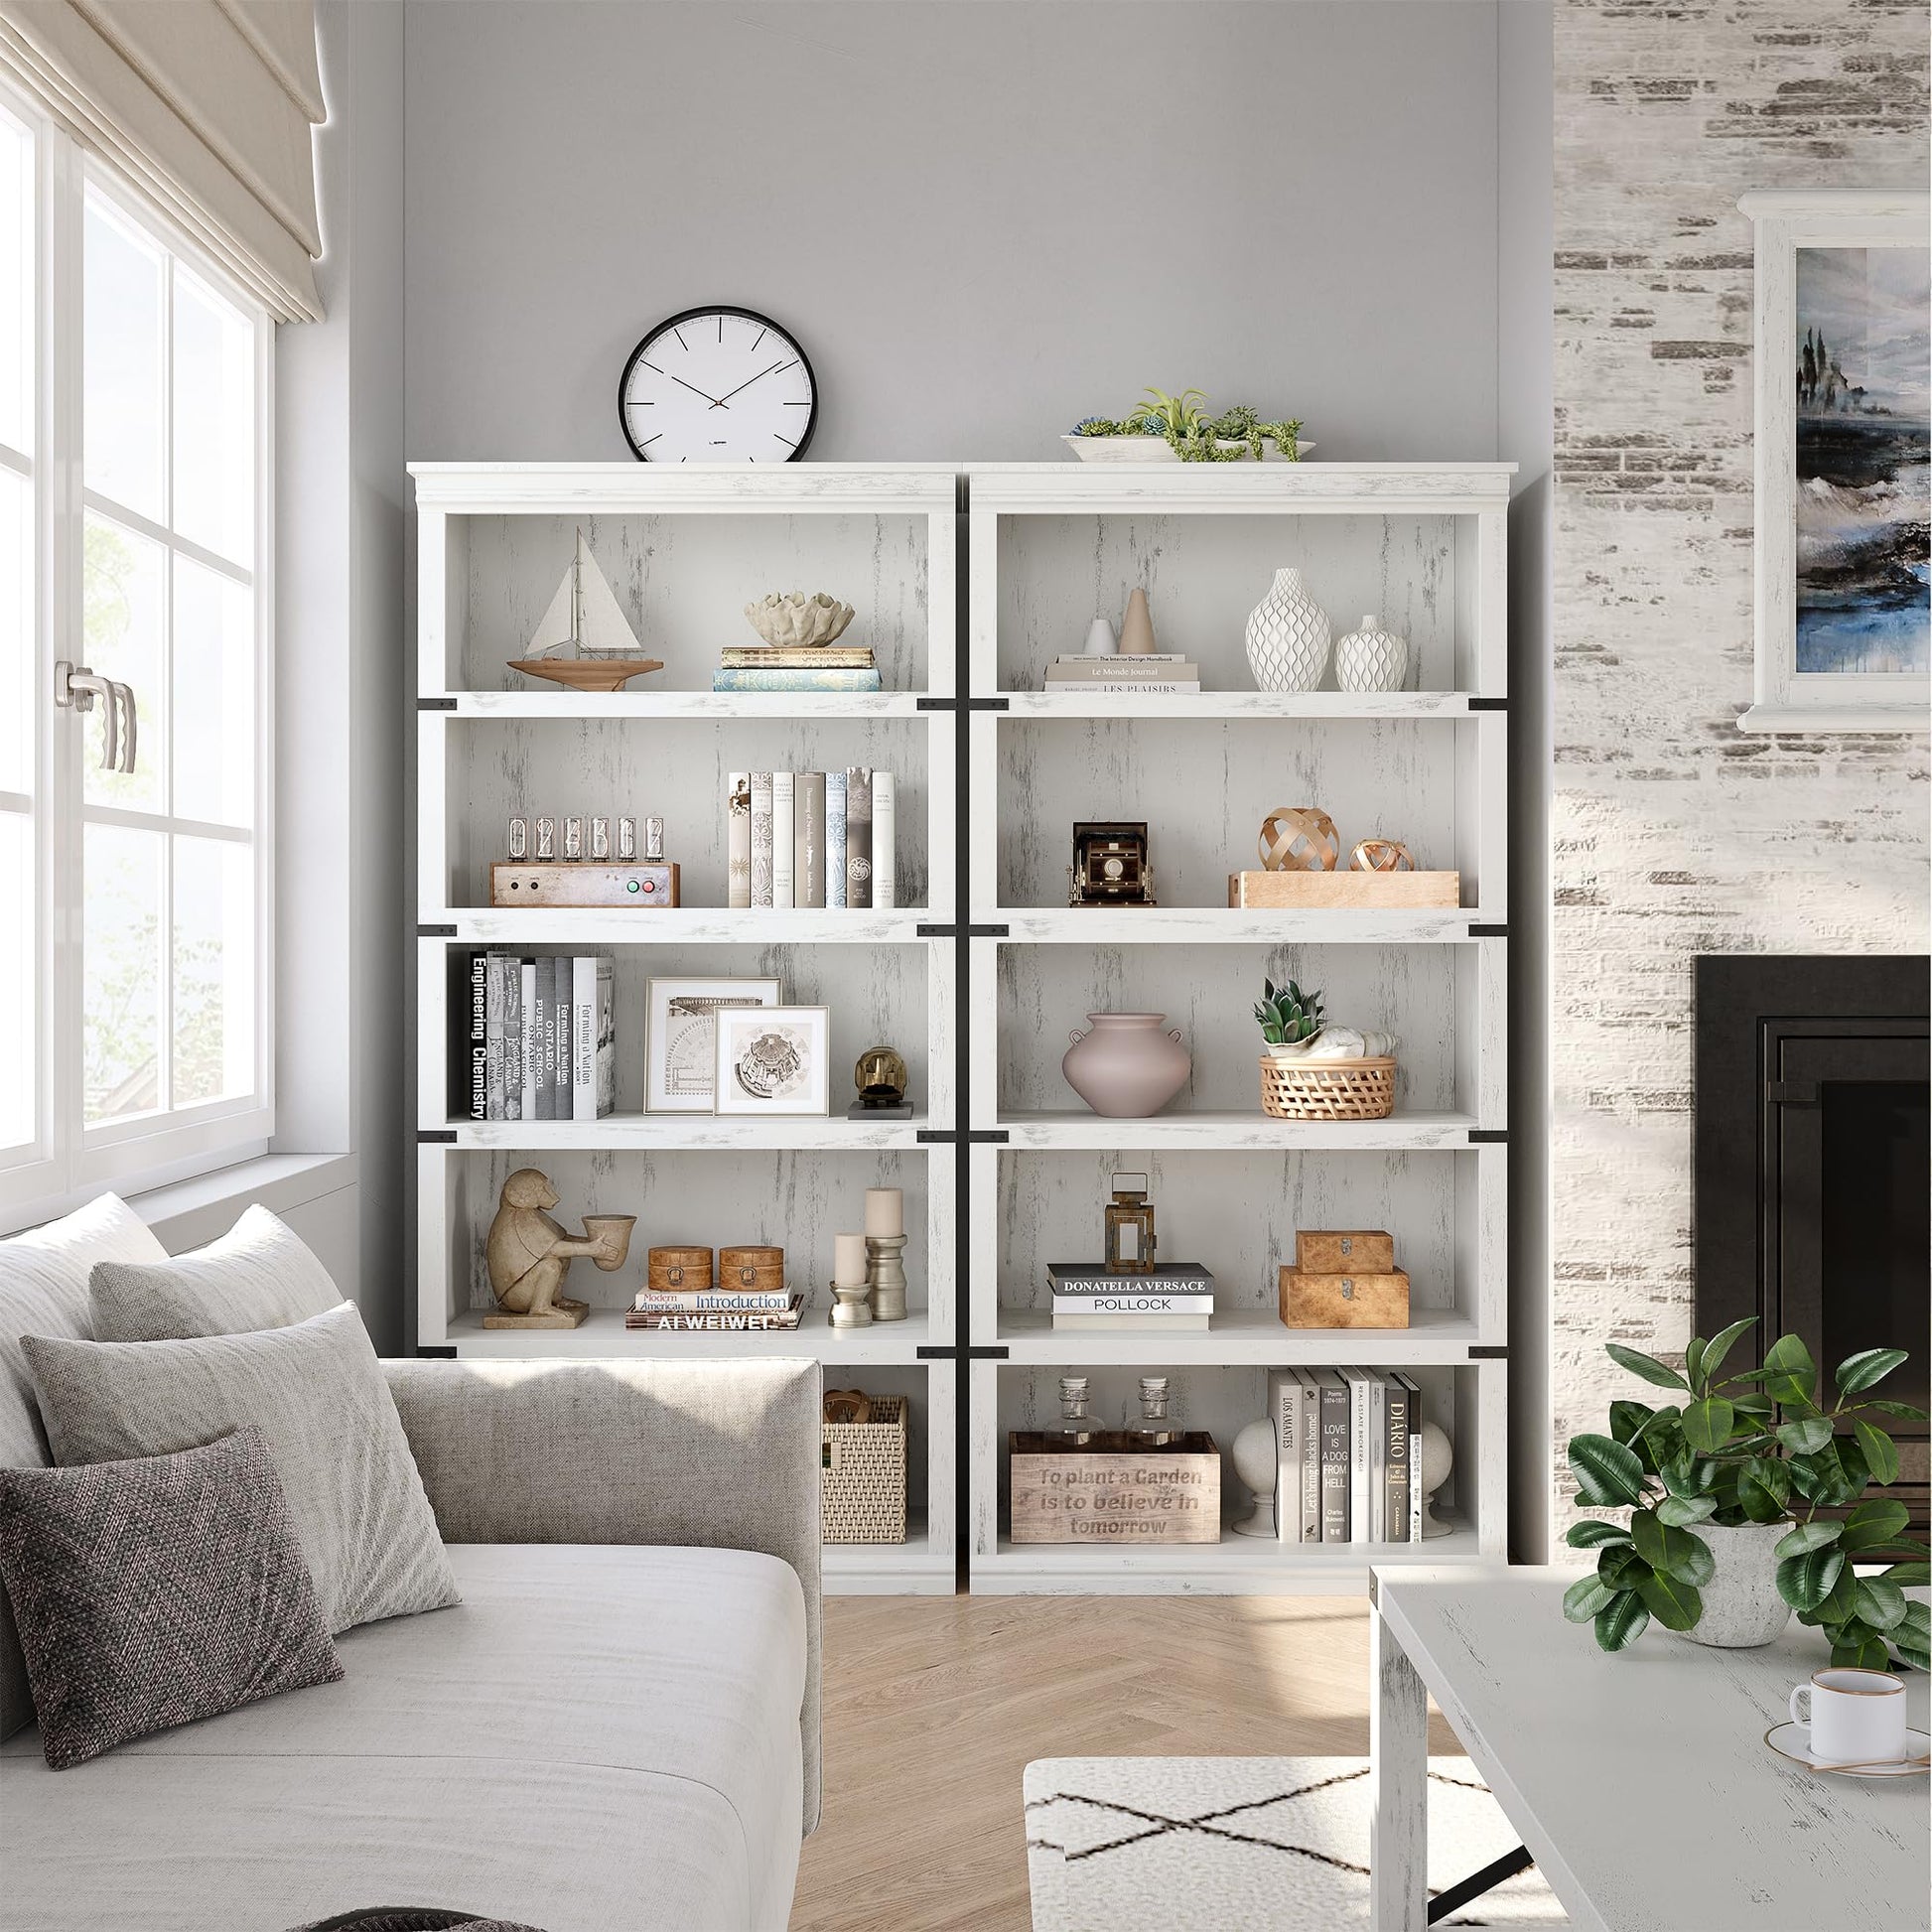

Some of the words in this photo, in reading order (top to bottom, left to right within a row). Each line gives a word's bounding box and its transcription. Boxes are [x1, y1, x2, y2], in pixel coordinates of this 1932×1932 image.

[471, 958, 486, 1039] Engineering
[560, 1004, 569, 1044] Forming
[581, 1004, 592, 1044] Forming
[487, 1035, 503, 1078] ENGLAND
[504, 1035, 520, 1078] ENGLAND
[582, 1053, 592, 1085] Nation
[471, 1047, 486, 1120] Chemistry
[1064, 1281, 1143, 1292] DONATELLA
[1146, 1281, 1206, 1292] VERSACE
[640, 1302, 684, 1311] American
[696, 1295, 786, 1309] Introduction
[1094, 1299, 1172, 1311] POLLOCK
[1283, 1397, 1293, 1412] LOS
[1283, 1413, 1293, 1449] AMANTES
[1306, 1413, 1317, 1441] home!
[1323, 1425, 1346, 1435] LOVE
[1390, 1403, 1408, 1458] DIÁRIO
[1331, 1438, 1339, 1448] IS
[1306, 1442, 1317, 1468] blacks
[1321, 1451, 1328, 1460] A
[1329, 1451, 1348, 1460] DOG
[1040, 1468, 1060, 1485] To
[1065, 1468, 1115, 1488] plant
[1119, 1472, 1130, 1484] a
[1135, 1468, 1202, 1485] Garden
[1322, 1464, 1347, 1475] FROM
[1306, 1468, 1319, 1492] bring
[1324, 1478, 1346, 1488] HELL
[1041, 1493, 1058, 1510] is
[1064, 1494, 1087, 1510] to
[1093, 1493, 1172, 1510] believe
[1178, 1493, 1199, 1510] in
[1070, 1518, 1168, 1535] tomorrow
